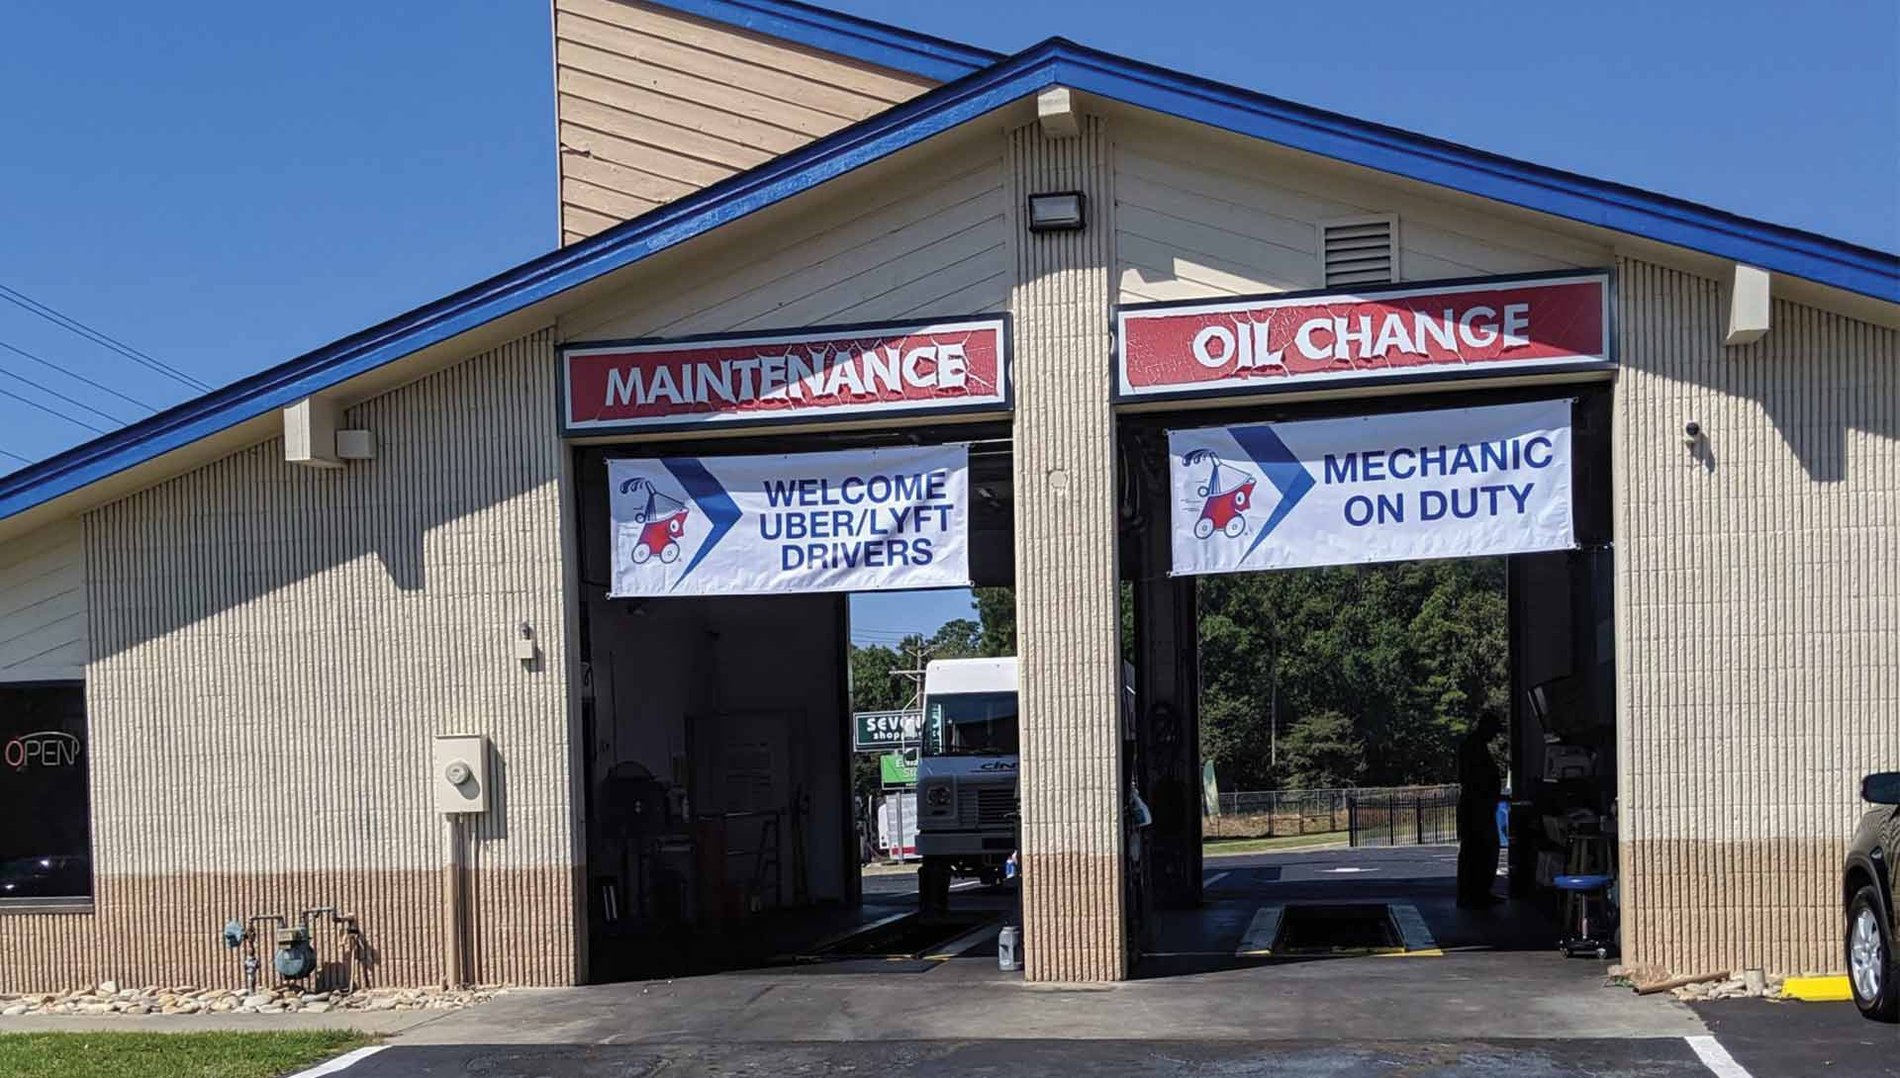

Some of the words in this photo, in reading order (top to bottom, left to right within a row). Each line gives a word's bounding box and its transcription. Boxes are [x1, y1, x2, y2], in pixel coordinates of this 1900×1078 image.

[1192, 318, 1285, 368] OIL
[1295, 303, 1530, 361] CHANGE
[605, 344, 967, 406] MAINTENANCE
[1323, 436, 1554, 485] MECHANIC
[763, 472, 947, 508] WELCOME
[1344, 492, 1405, 527] ON
[1420, 483, 1535, 522] DUTY
[759, 504, 955, 541] UBER/LYFT
[781, 537, 934, 572] DRIVERS
[6, 740, 75, 766] OPEN
